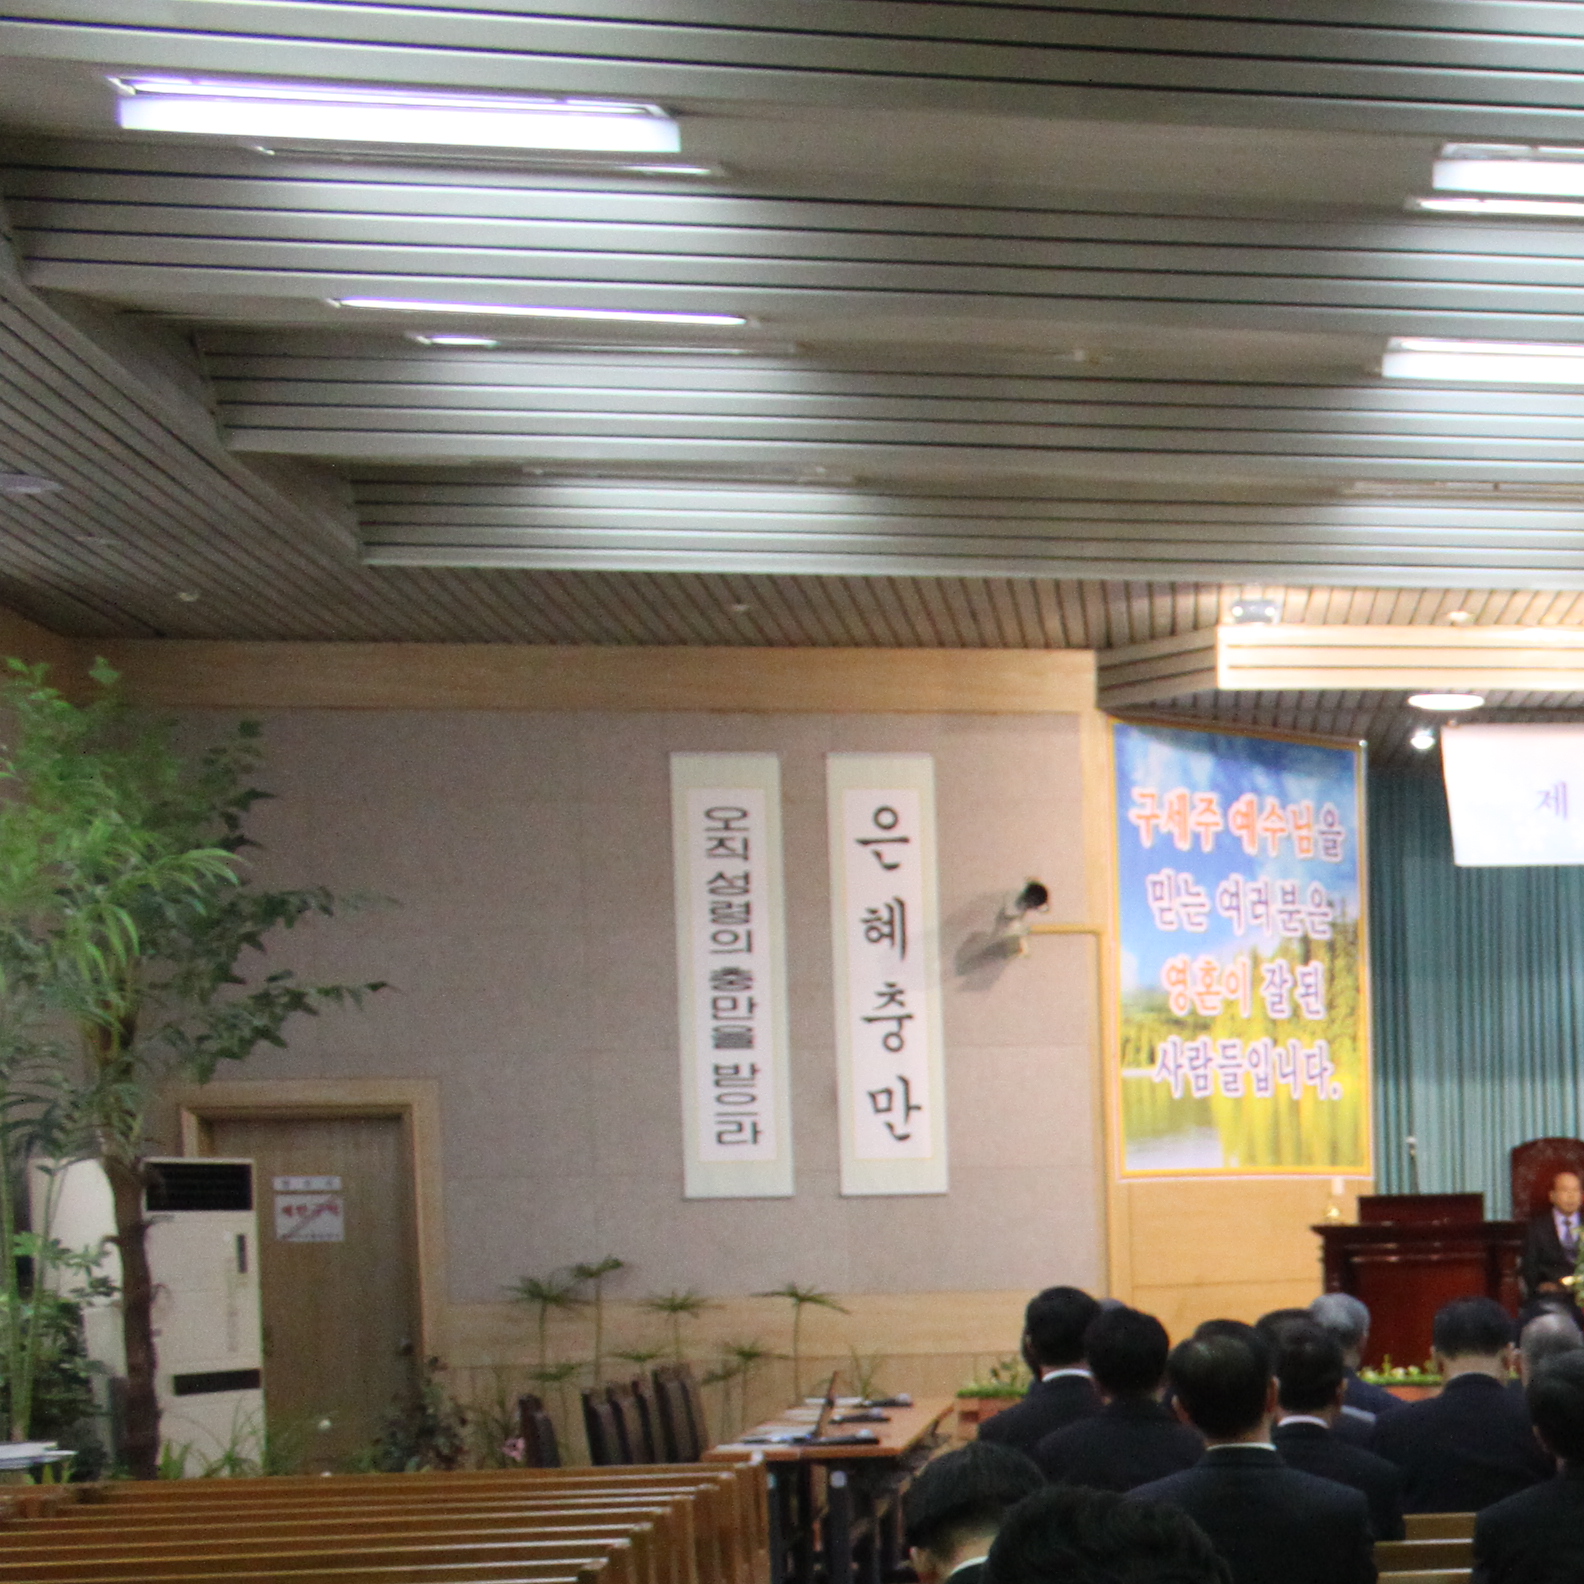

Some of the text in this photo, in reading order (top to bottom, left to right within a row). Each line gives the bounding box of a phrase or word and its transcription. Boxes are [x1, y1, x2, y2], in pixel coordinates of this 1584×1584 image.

[1130, 787, 1346, 862] 구세주 예수님을
[1146, 868, 1334, 939] 믿는 여러분은
[704, 806, 762, 1145] 오직 성령의 충만을 받으라
[1162, 954, 1327, 1019] 영혼이 잘된
[1153, 1035, 1343, 1099] 사람들입니다.
